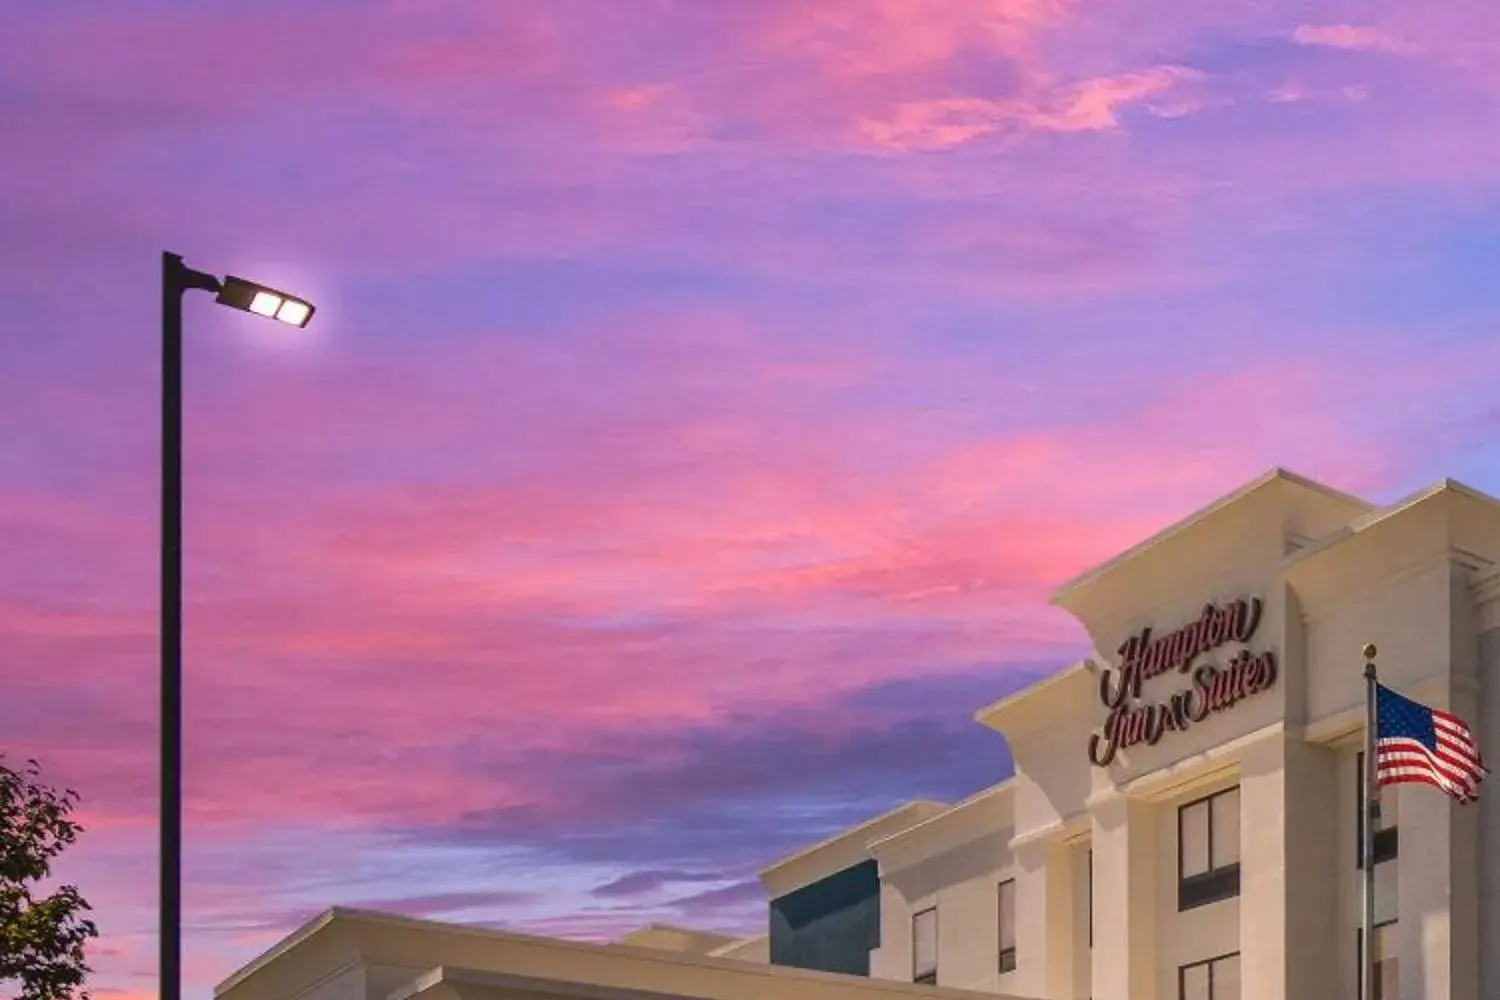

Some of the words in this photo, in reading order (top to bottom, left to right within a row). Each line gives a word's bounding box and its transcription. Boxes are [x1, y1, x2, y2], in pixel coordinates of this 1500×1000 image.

[1088, 704, 1163, 768] Inn
[1183, 650, 1277, 722] Suites
[1100, 598, 1263, 709] Hampton
